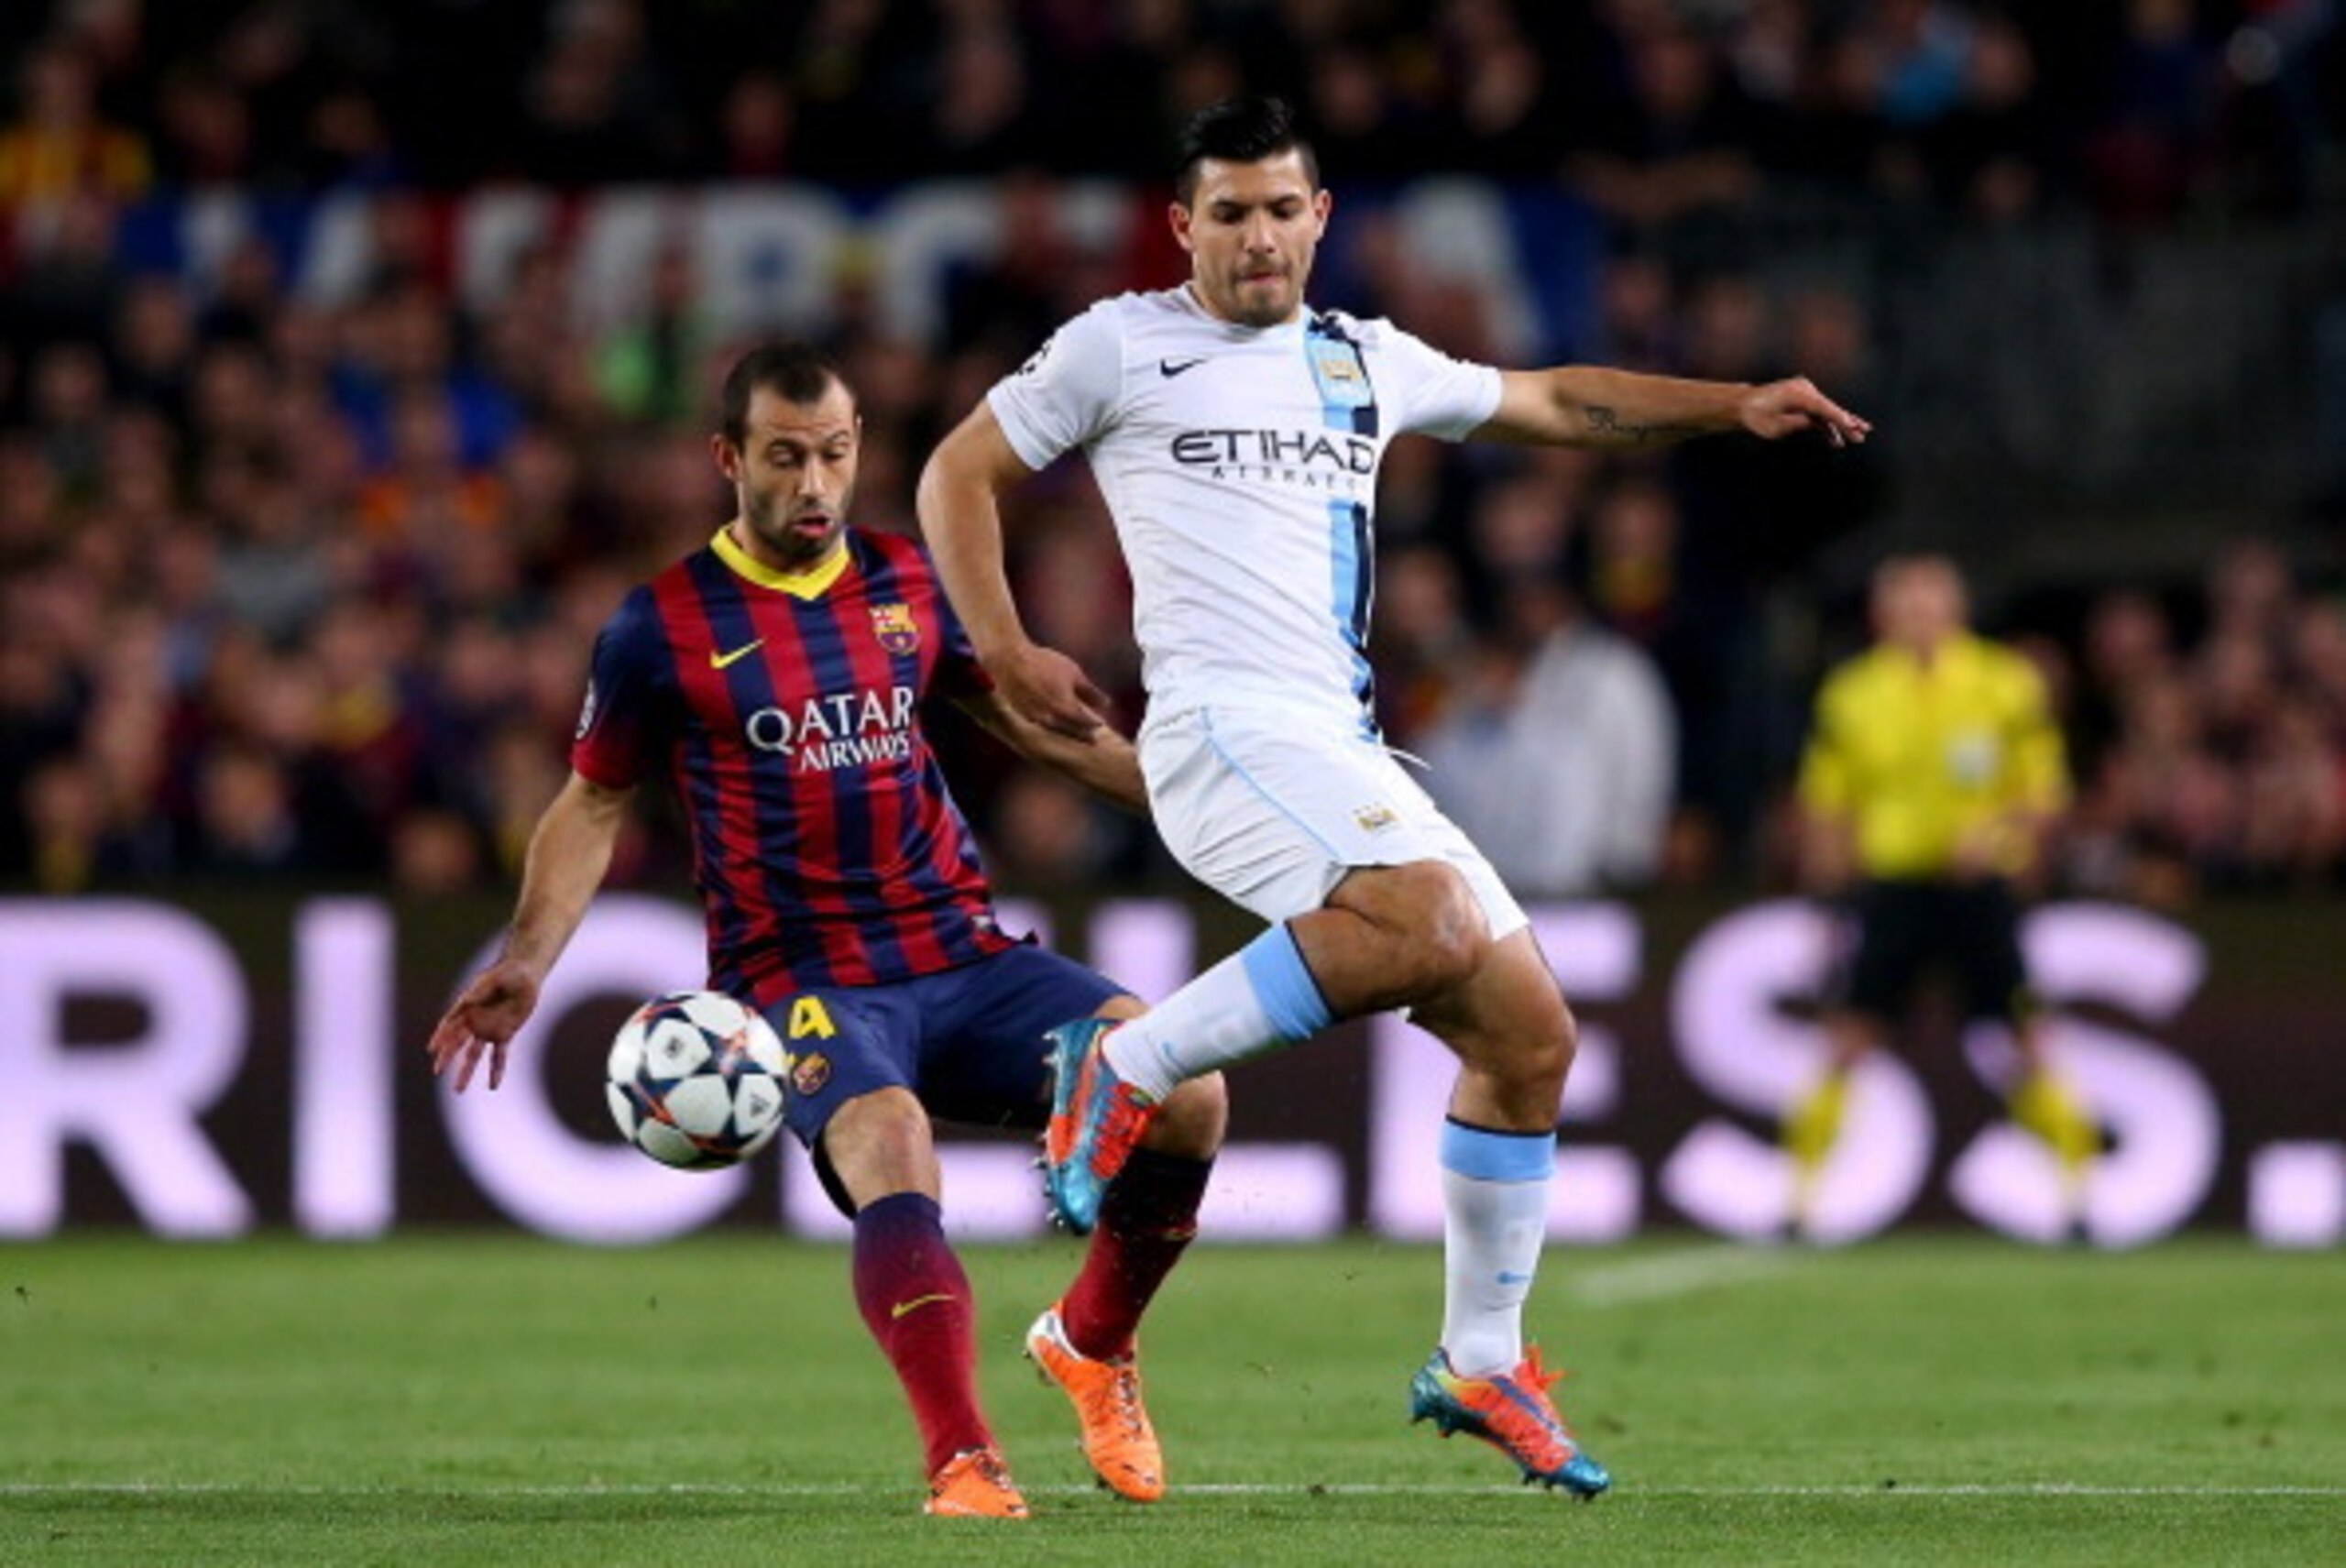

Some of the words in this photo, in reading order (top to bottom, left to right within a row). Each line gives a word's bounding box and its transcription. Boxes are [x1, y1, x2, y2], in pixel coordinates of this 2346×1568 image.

[1172, 429, 1375, 476] ETIHAD
[745, 685, 914, 755] QATAR
[800, 731, 910, 772] AIRWAYS
